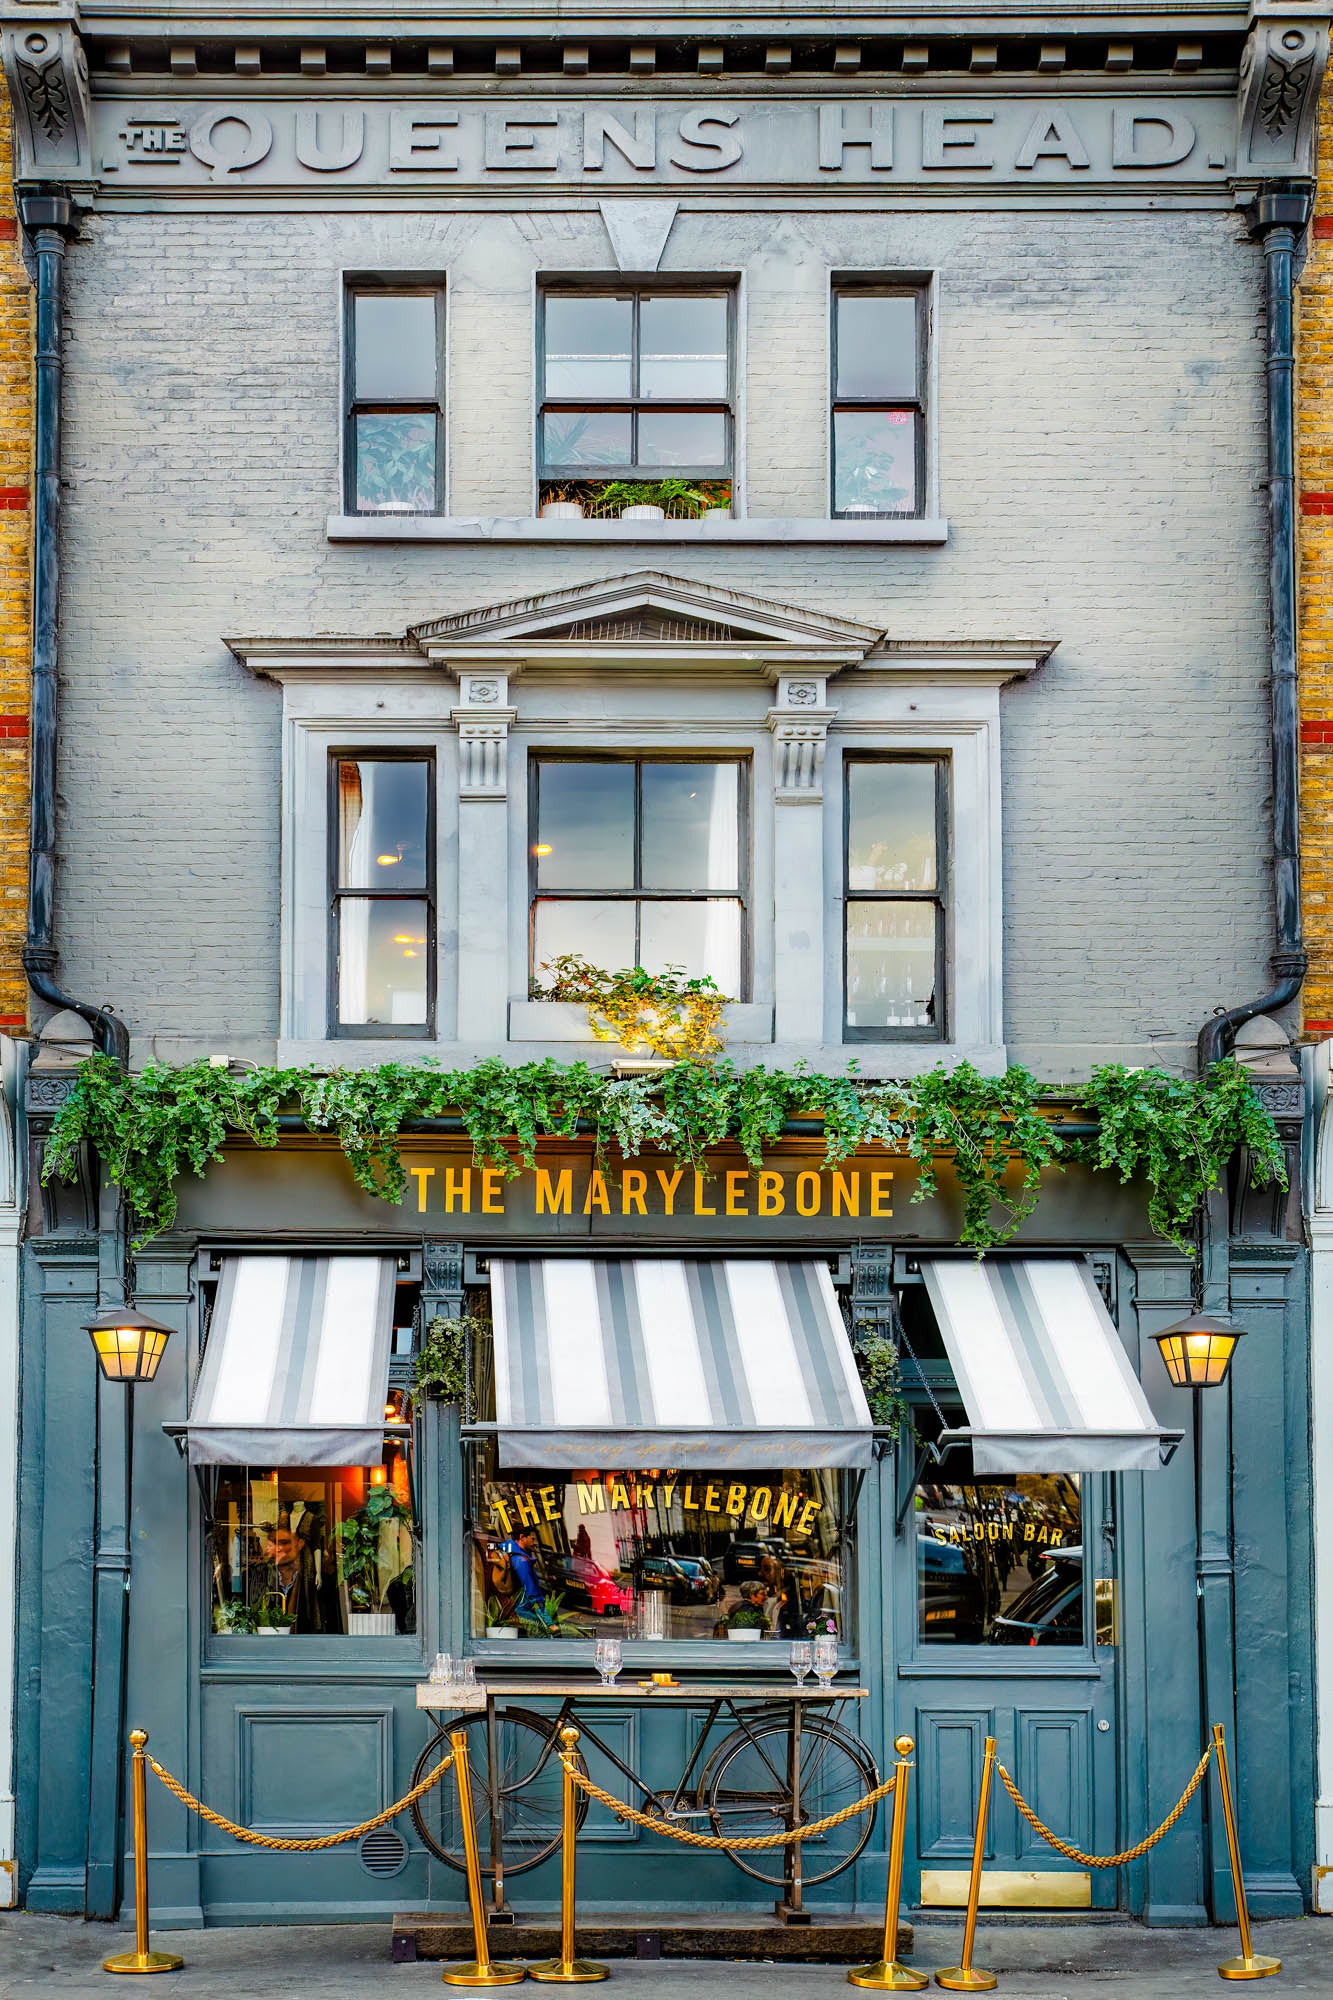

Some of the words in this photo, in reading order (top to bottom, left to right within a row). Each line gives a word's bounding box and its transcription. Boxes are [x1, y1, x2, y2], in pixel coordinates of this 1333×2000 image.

[118, 128, 187, 152] THE
[188, 108, 743, 181] QUEENS
[410, 1167, 506, 1214] THE
[535, 1169, 894, 1217] MARYLEBONE
[719, 1438, 751, 1462] of
[491, 1485, 562, 1534] THE
[576, 1475, 822, 1536] MARYLEBONE
[935, 1522, 1014, 1546] SALOON
[1023, 1523, 1063, 1546] BAR
